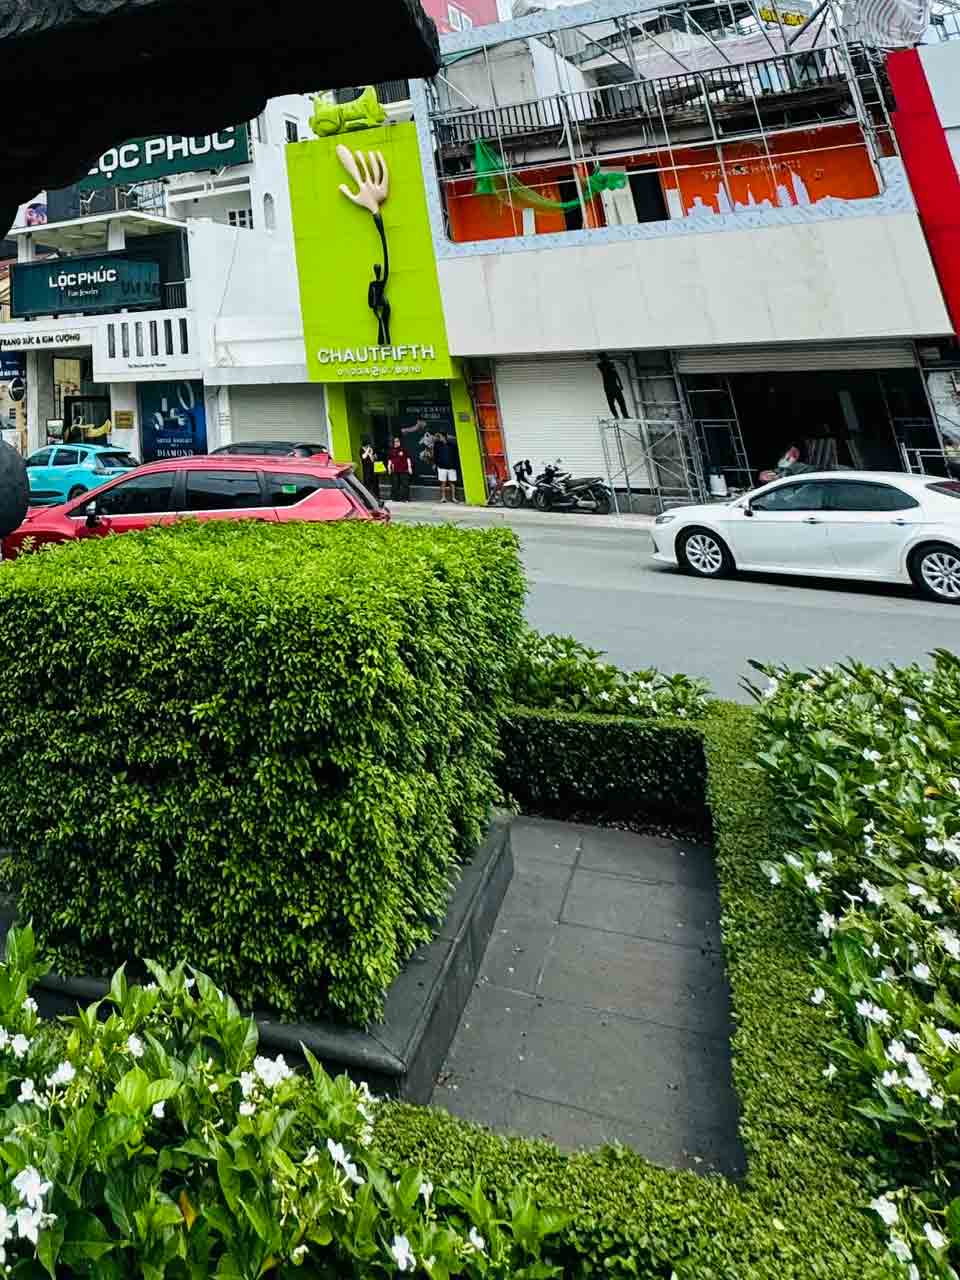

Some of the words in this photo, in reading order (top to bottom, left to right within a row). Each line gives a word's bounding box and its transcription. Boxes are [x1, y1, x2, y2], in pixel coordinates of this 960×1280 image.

[49, 271, 77, 291] LỘC
[78, 265, 117, 285] PHÚC
[36, 336, 41, 344] &
[42, 335, 54, 344] KIM
[317, 344, 436, 364] CHAUTFIFTH
[157, 449, 193, 457] DIAMOND
